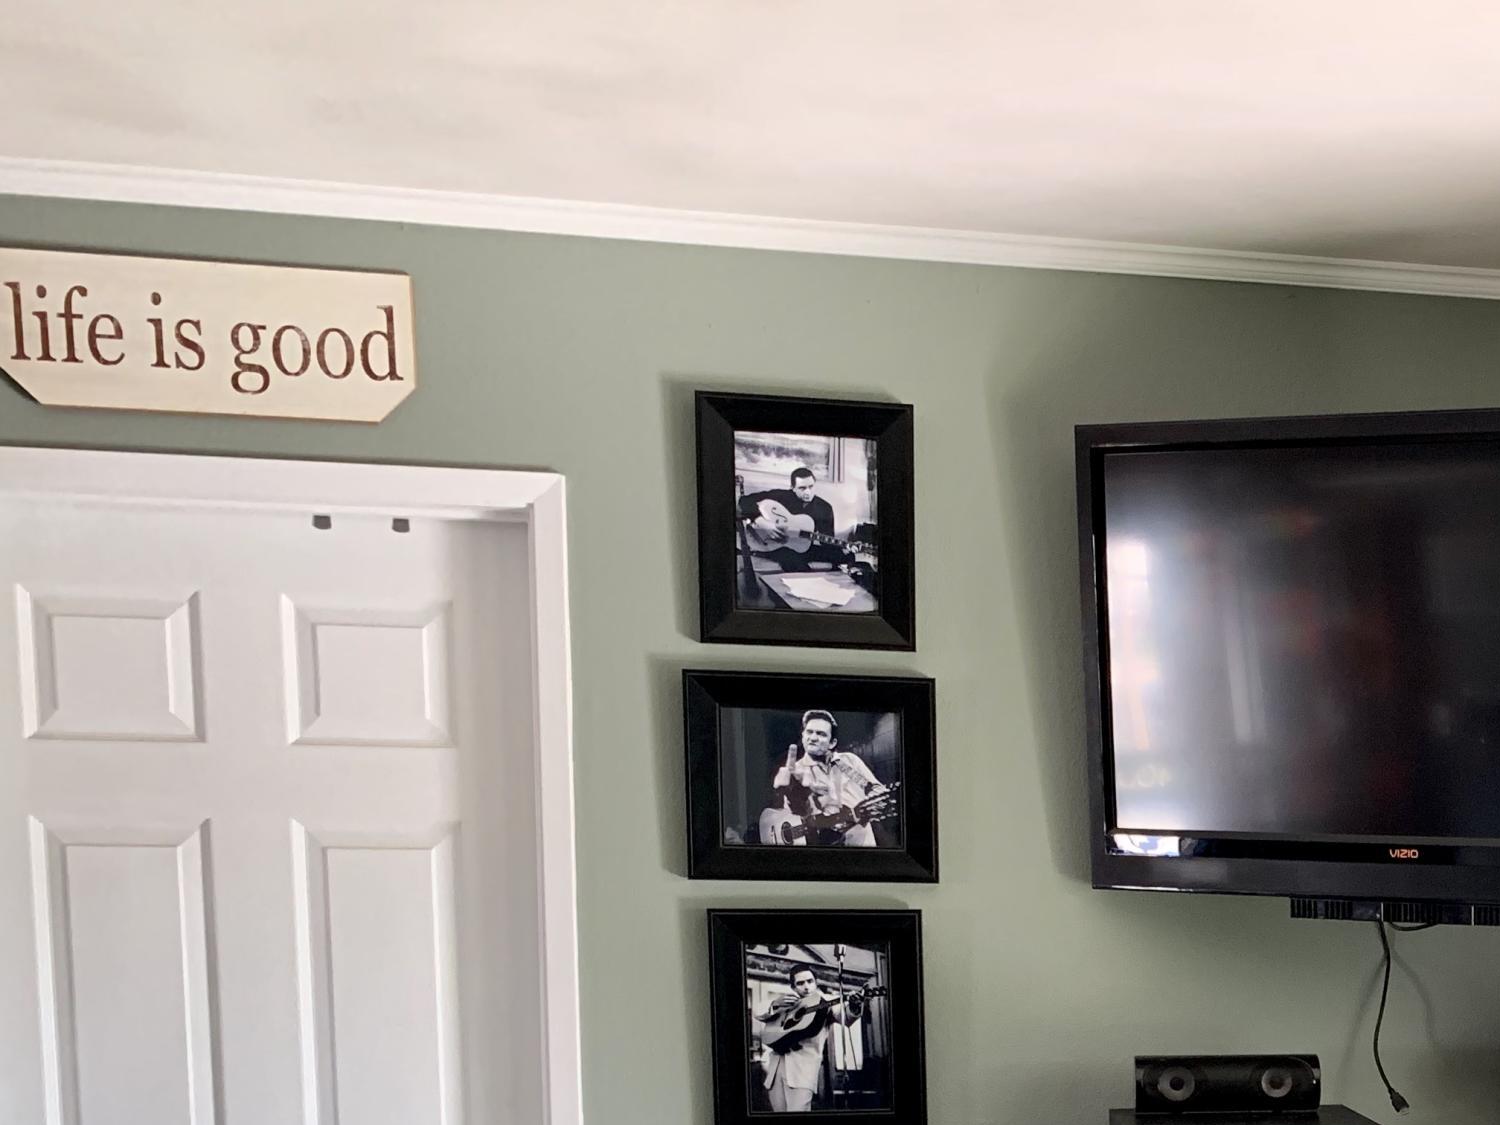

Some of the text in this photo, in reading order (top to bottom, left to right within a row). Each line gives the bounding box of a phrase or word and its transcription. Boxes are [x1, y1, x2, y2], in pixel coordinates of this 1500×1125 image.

[3, 281, 404, 395] life is good
[1389, 848, 1419, 859] VIZIO
